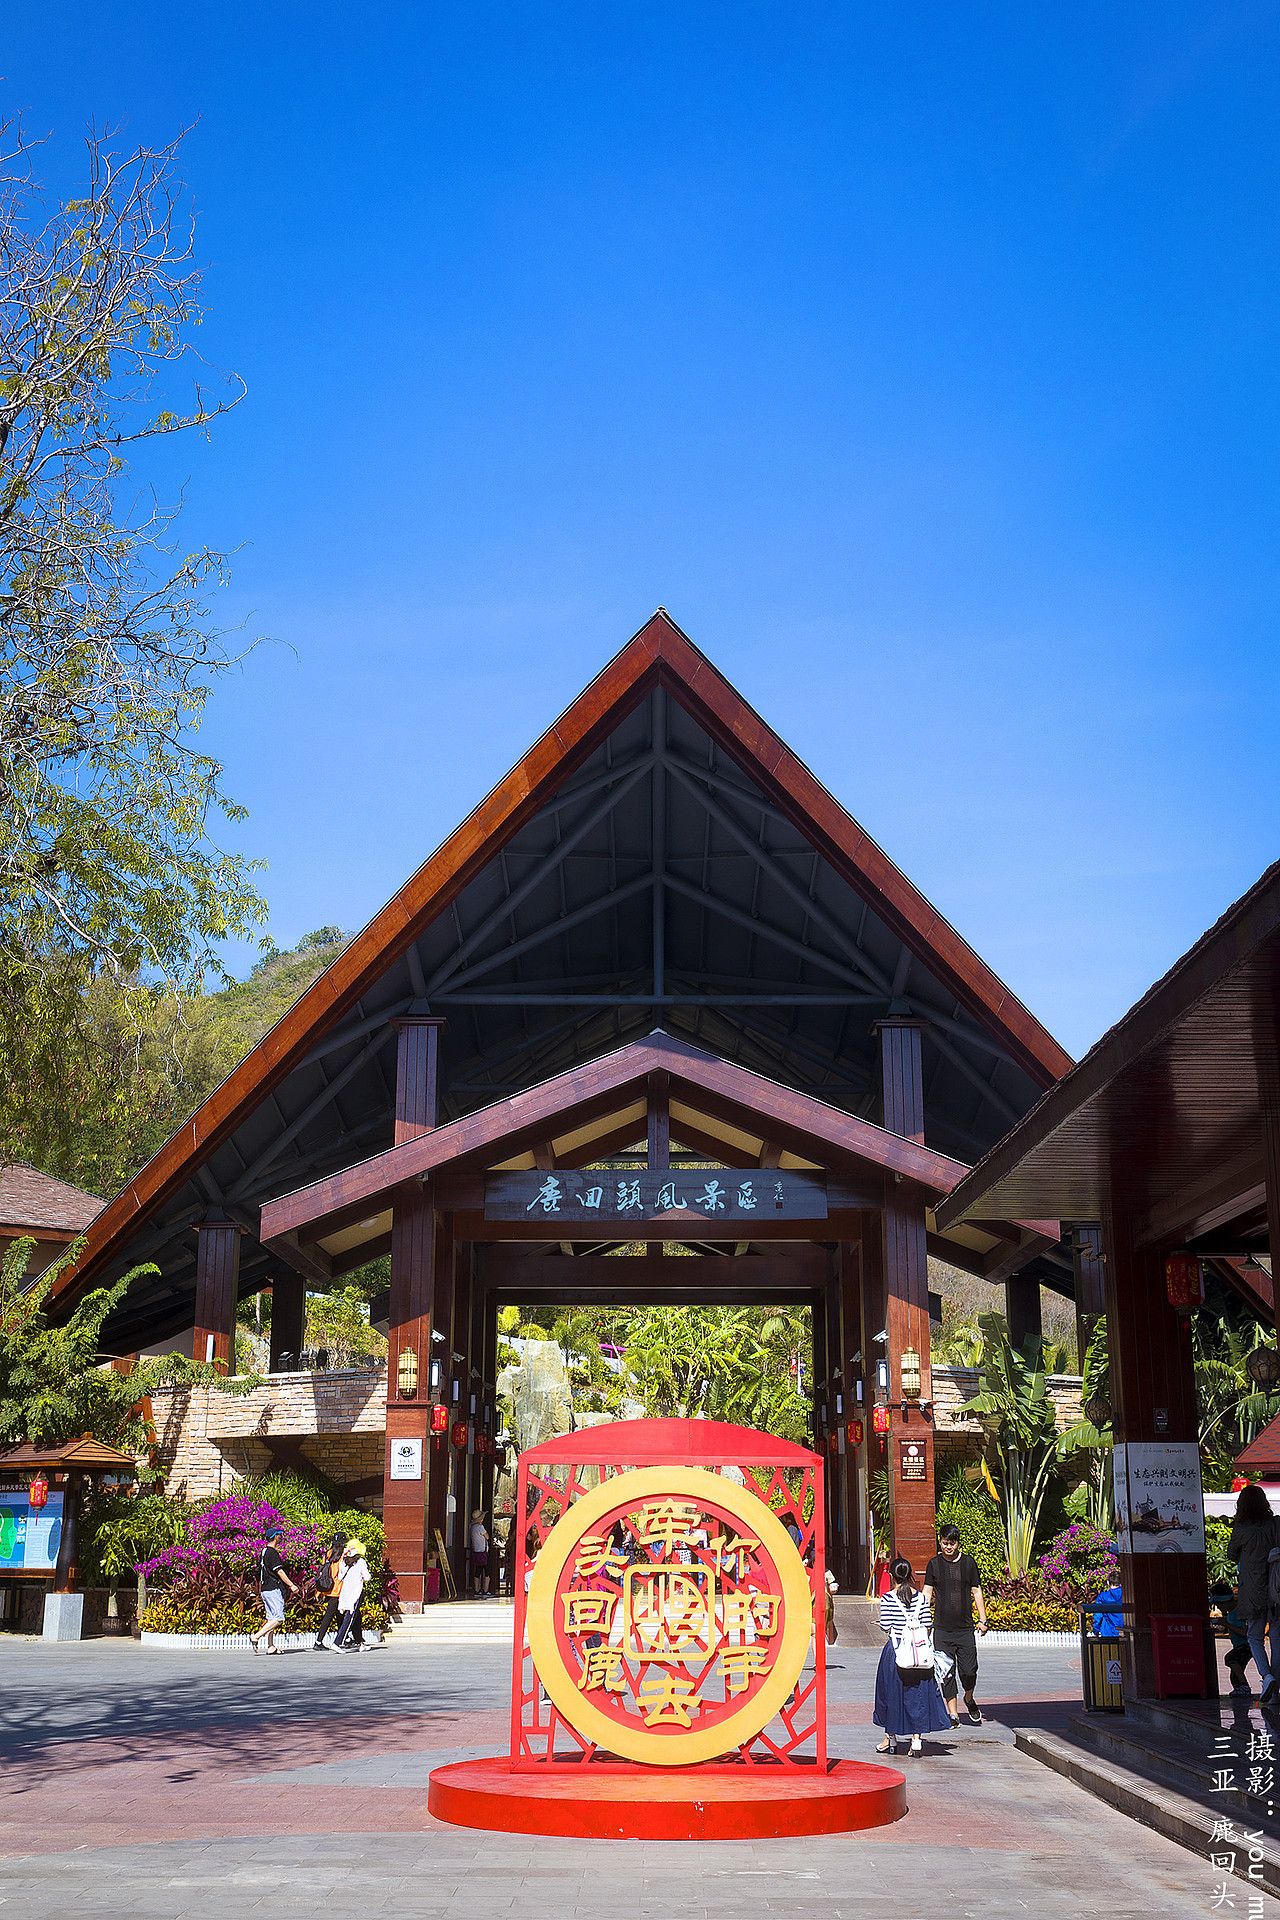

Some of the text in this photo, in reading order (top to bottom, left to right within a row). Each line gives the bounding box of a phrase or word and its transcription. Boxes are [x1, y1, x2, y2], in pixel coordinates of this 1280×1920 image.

[1133, 1468, 1197, 1479] 生态兴则文明兴
